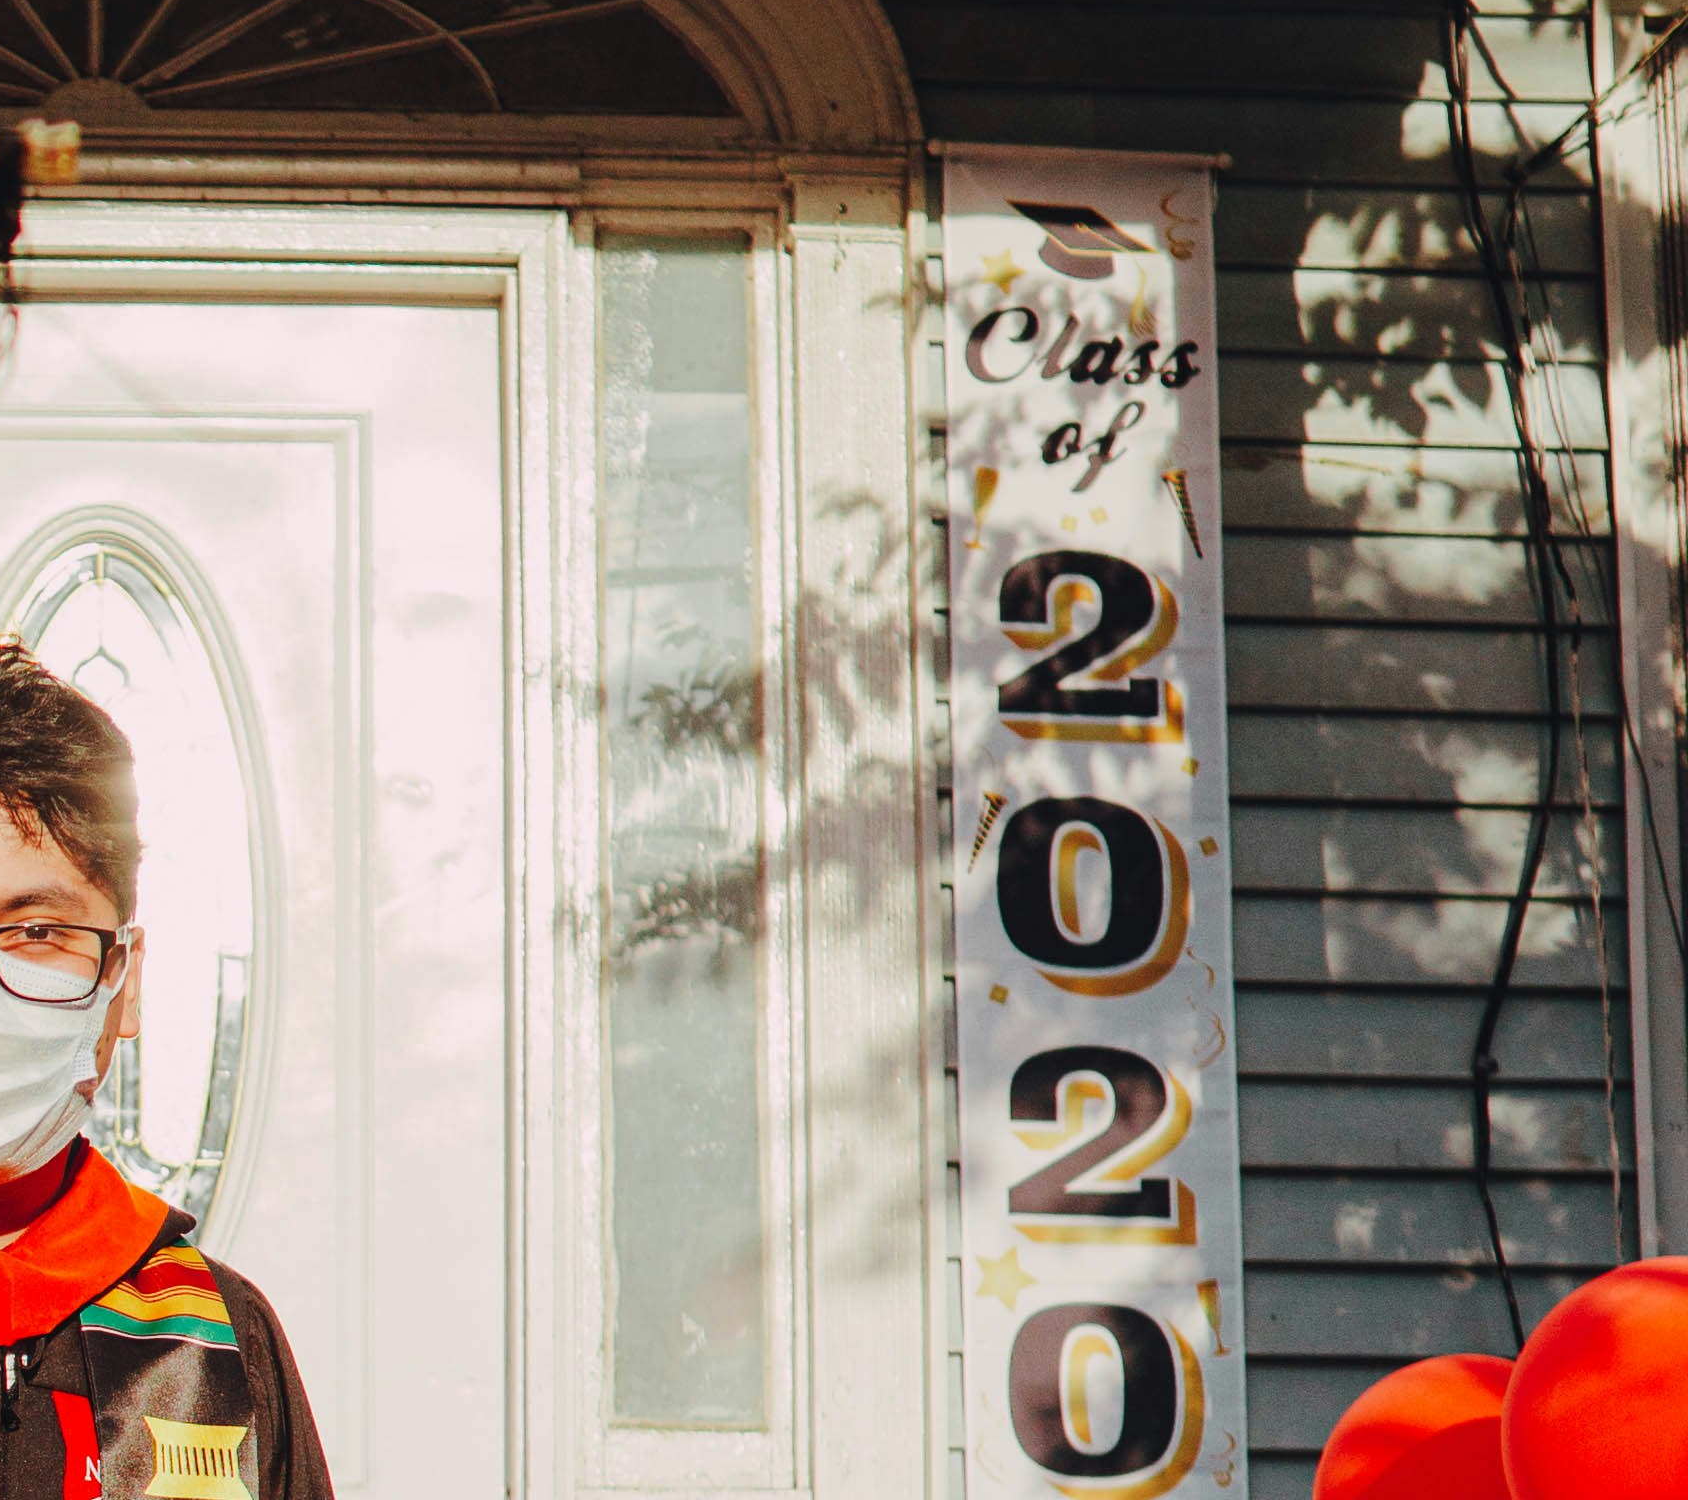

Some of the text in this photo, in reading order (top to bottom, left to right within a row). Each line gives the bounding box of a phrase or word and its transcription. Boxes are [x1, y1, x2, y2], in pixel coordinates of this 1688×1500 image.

[965, 306, 1201, 389] Class
[1041, 401, 1127, 493] of
[996, 549, 1179, 1480] 2020
